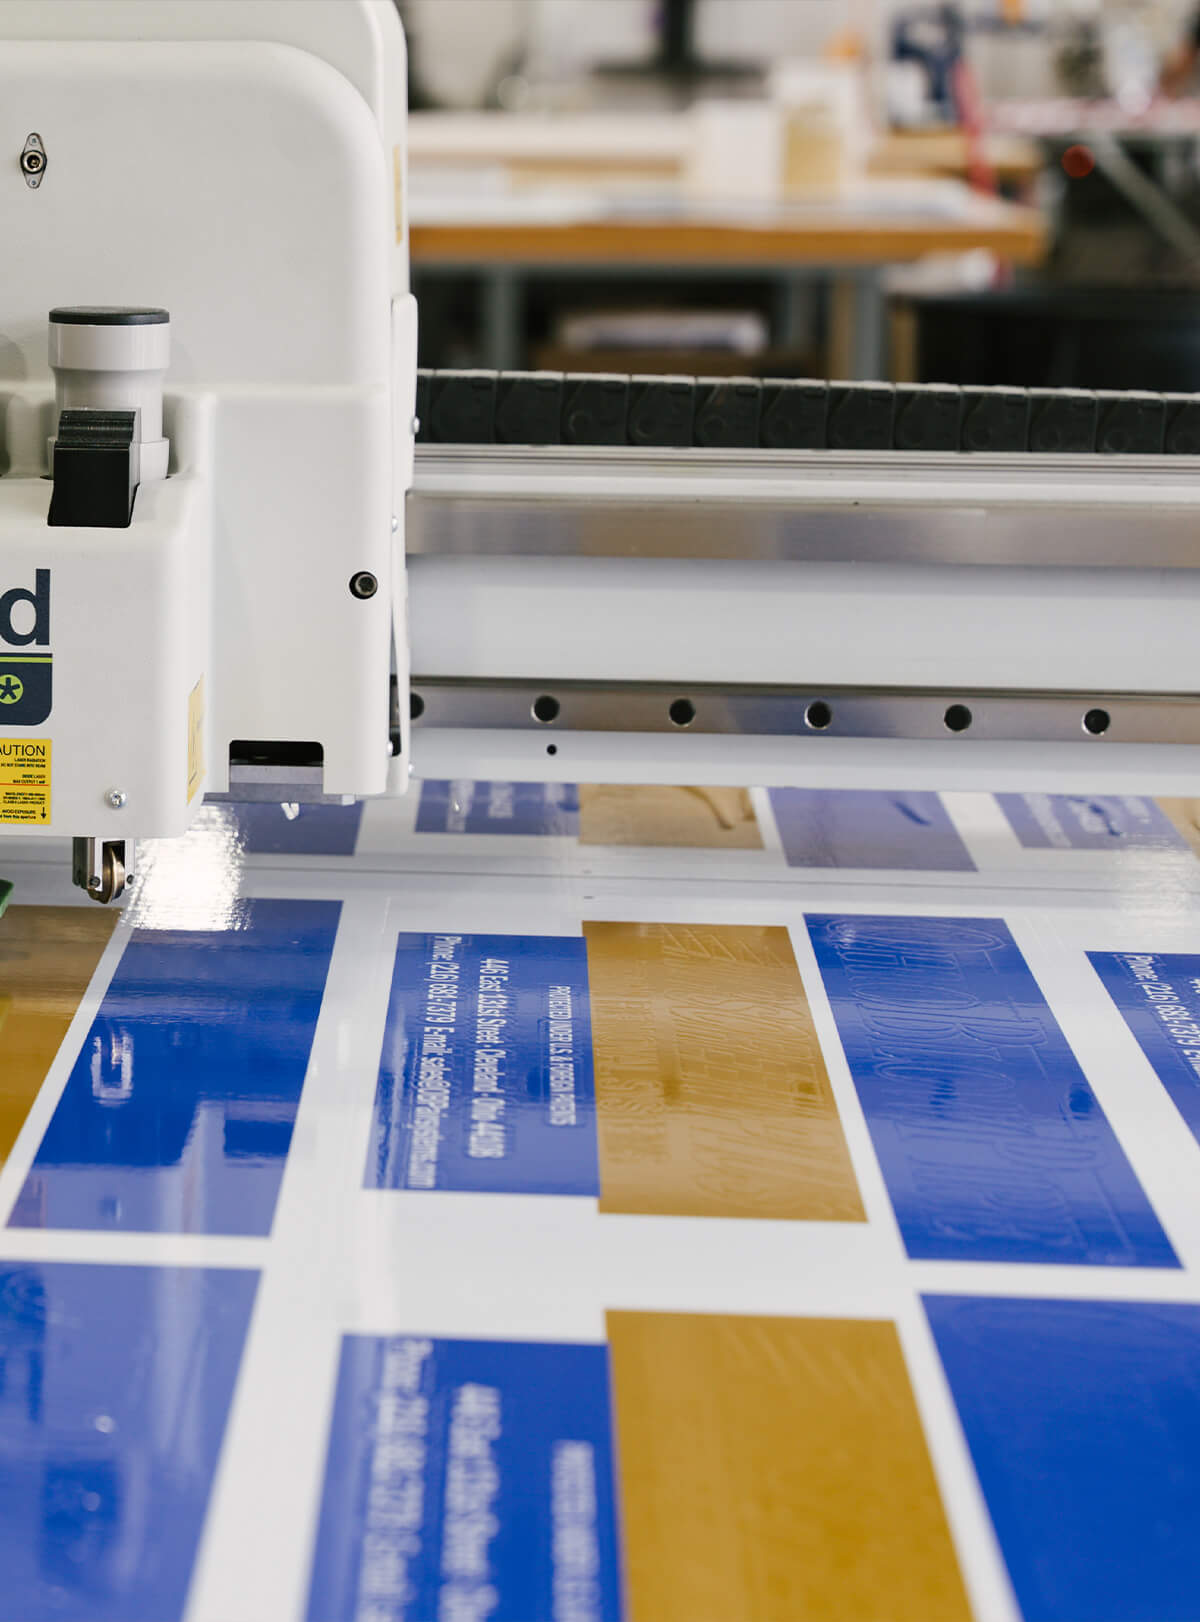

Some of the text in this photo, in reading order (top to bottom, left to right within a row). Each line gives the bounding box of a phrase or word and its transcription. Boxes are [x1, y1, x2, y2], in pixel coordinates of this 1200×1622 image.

[432, 935, 461, 960] Phone:
[422, 961, 459, 982] (216)
[479, 958, 507, 973] 446
[478, 975, 507, 992] East
[1134, 982, 1181, 1003] (216)
[423, 983, 457, 1023] 681-7379
[476, 993, 507, 1017] 131st
[422, 1026, 454, 1055] E-mail:
[474, 1018, 506, 1043] Street
[472, 1048, 506, 1092] Cleveland
[470, 1097, 505, 1120] Ohio
